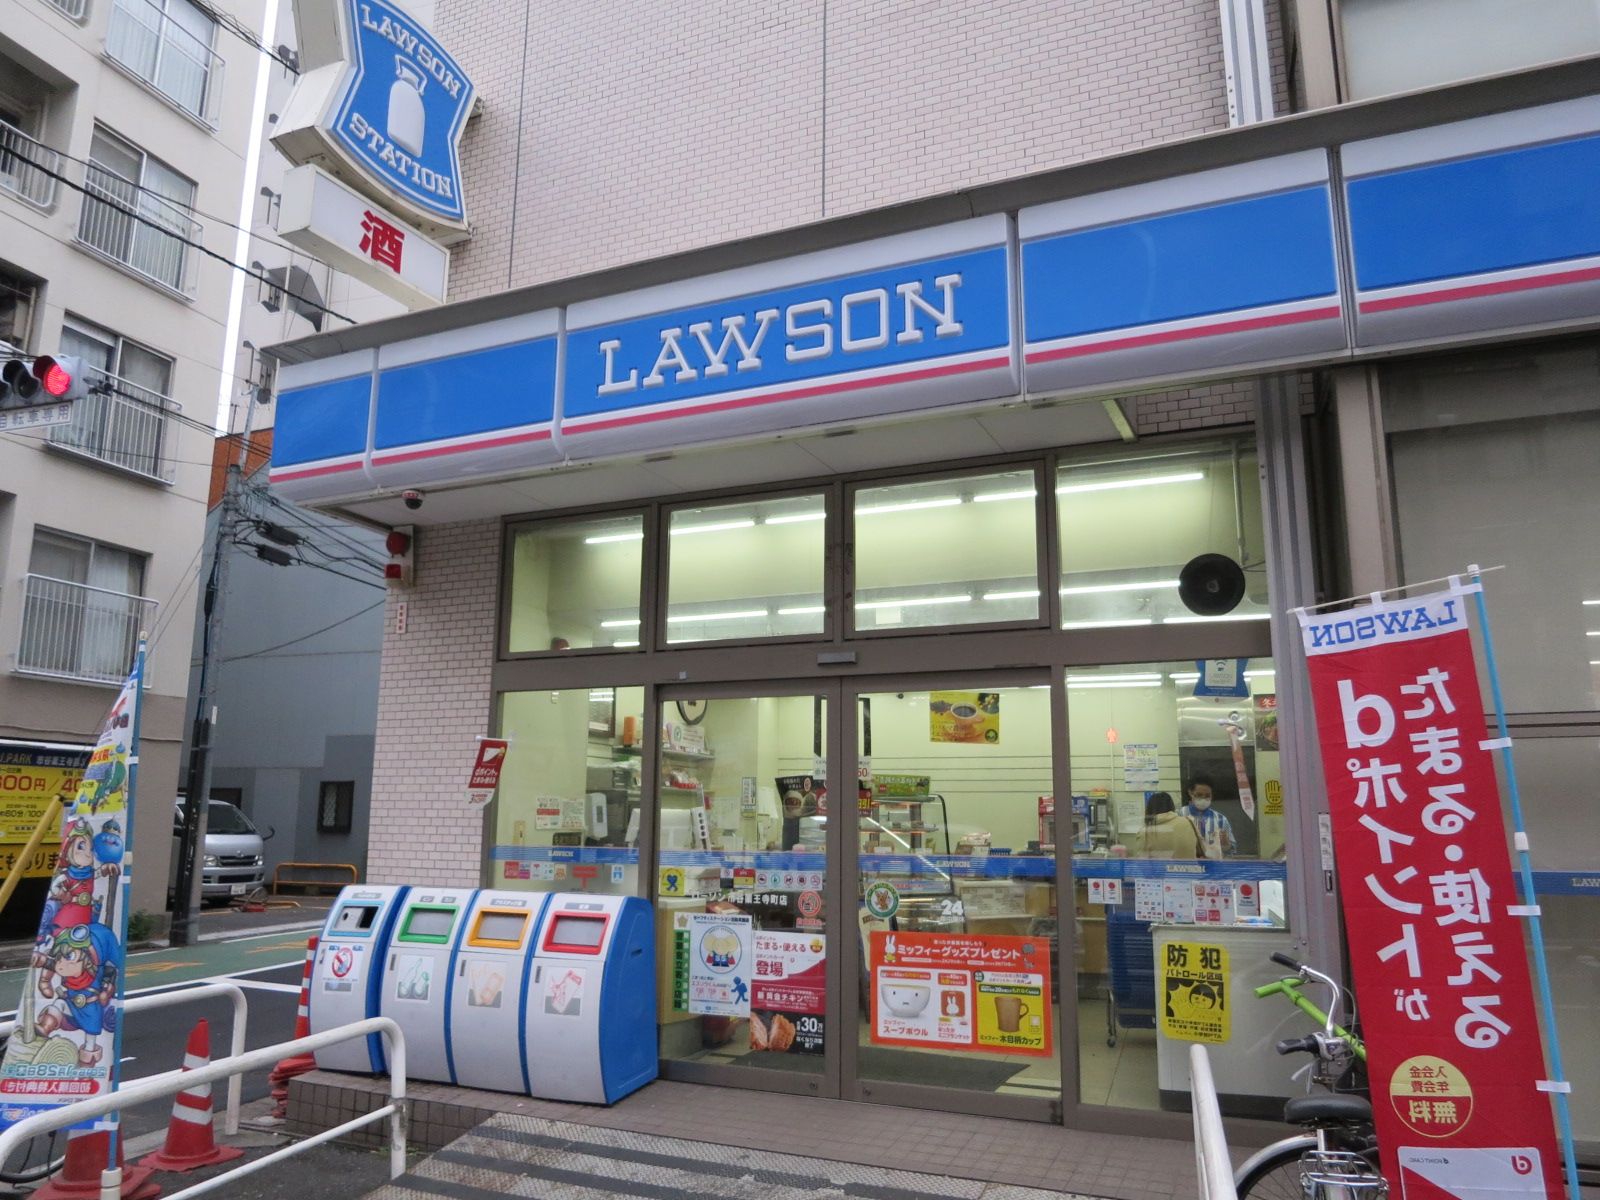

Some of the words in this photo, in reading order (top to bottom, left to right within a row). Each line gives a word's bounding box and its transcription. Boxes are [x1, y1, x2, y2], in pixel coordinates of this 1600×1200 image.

[361, 3, 462, 100] LAWSON
[349, 112, 453, 198] STATION
[358, 210, 405, 274] 酒
[597, 273, 963, 397] LAWSON
[1166, 864, 1206, 873] LAWSON
[941, 900, 964, 915] 24
[756, 941, 807, 953] たまる・使える
[897, 944, 1021, 960] ミッフィーグッズプレゼント
[1167, 944, 1222, 970] 防犯
[755, 959, 784, 977] 登場
[1166, 969, 1223, 980] パトロール区域
[800, 1016, 818, 1033] 30
[882, 1025, 929, 1037] スープボウル
